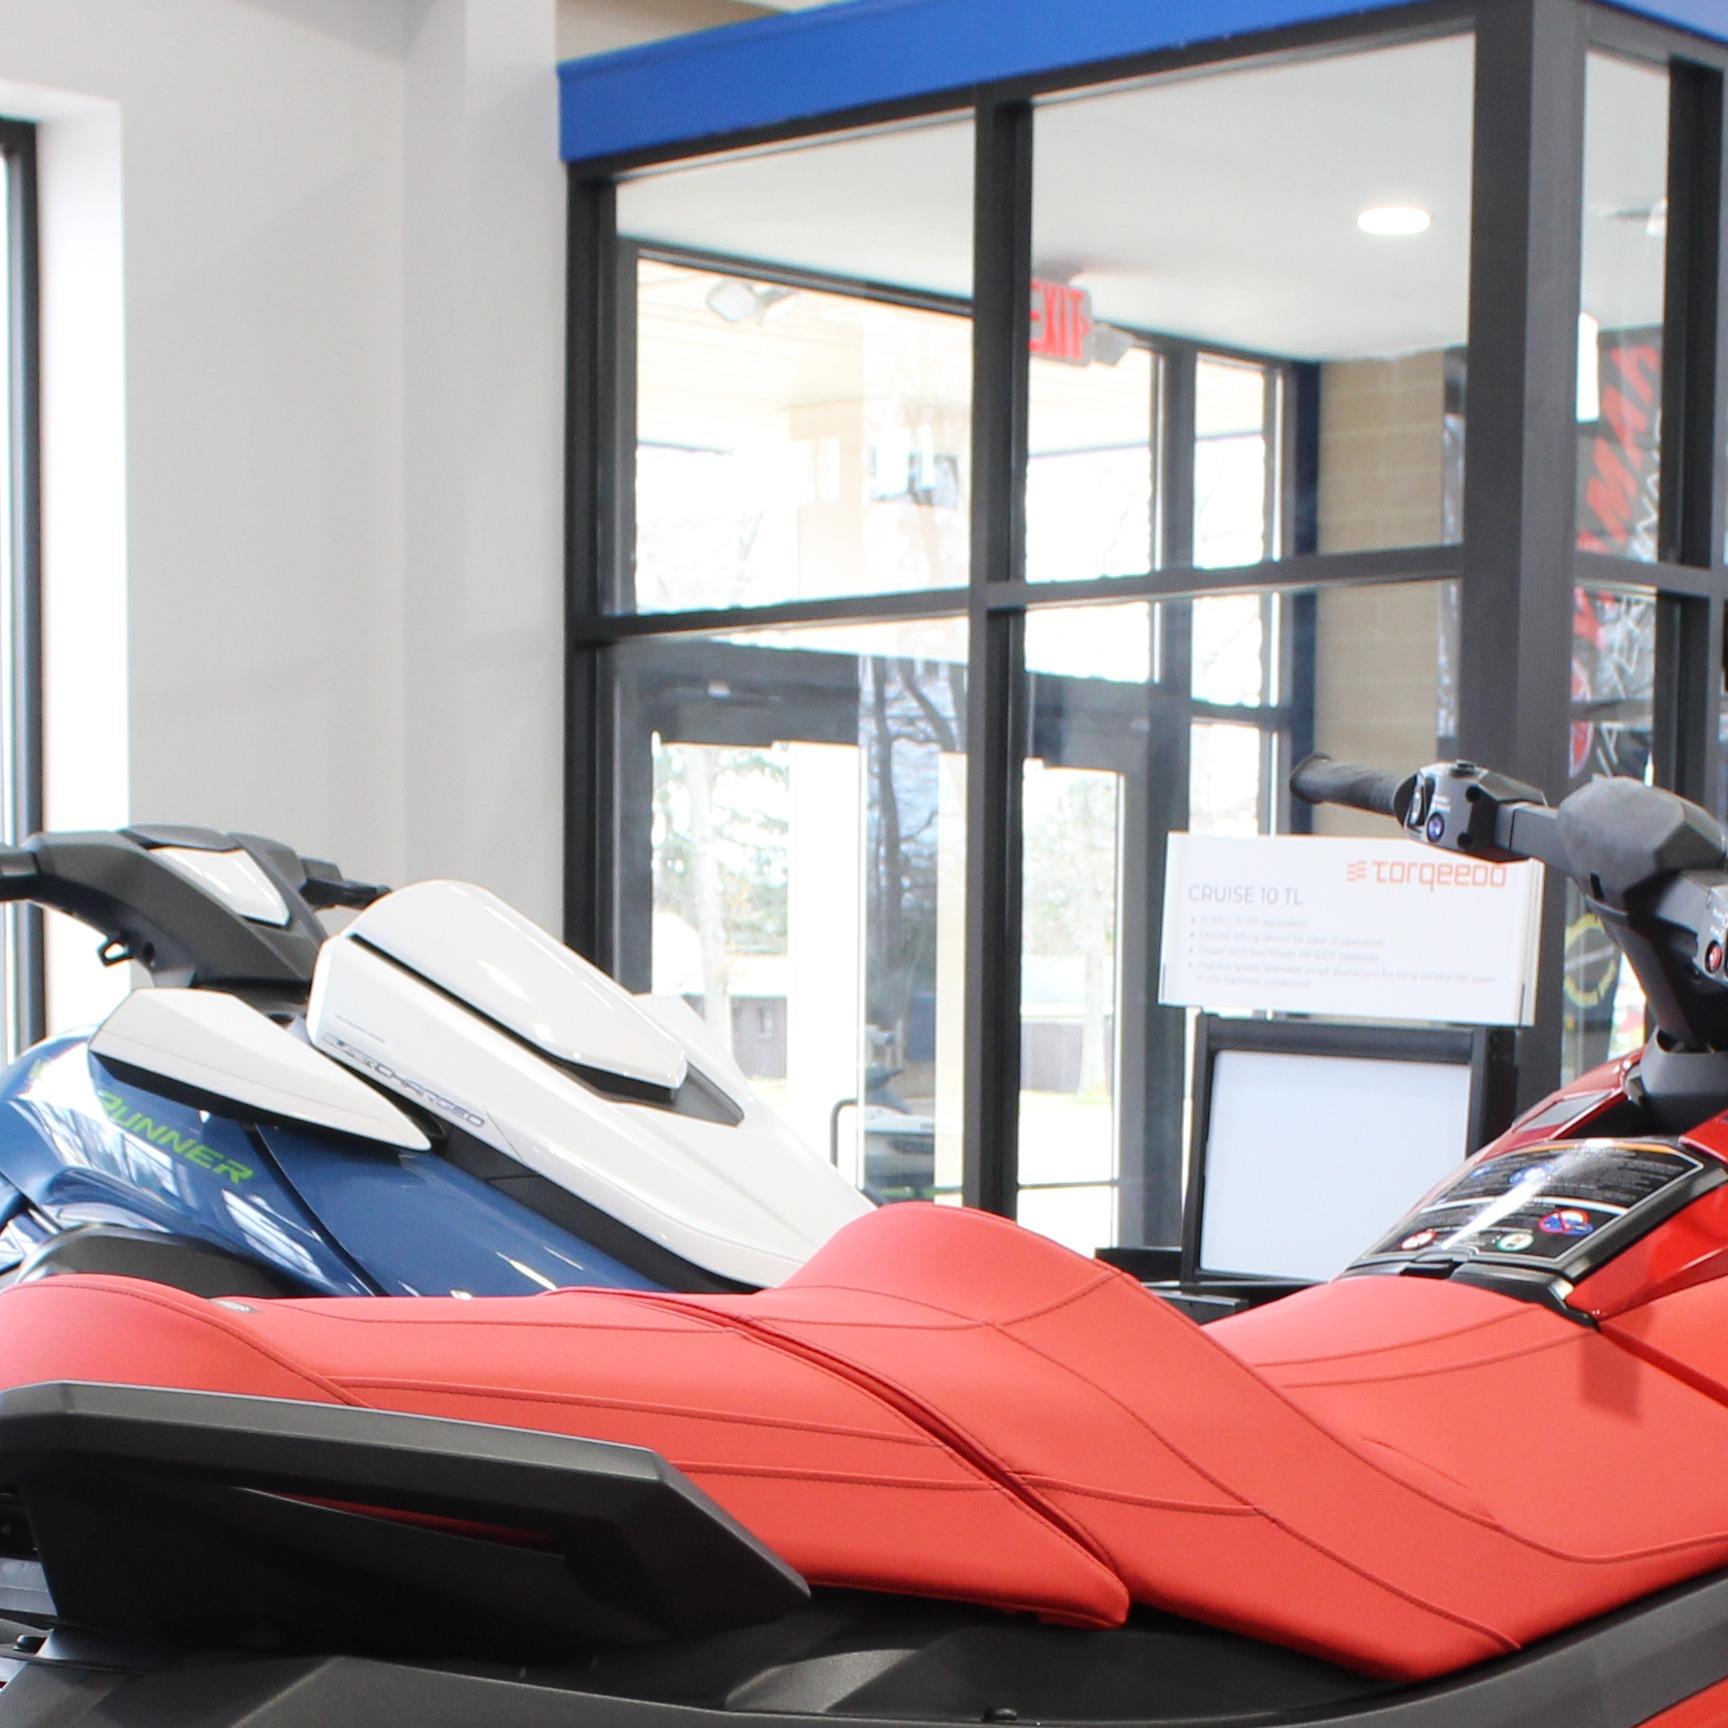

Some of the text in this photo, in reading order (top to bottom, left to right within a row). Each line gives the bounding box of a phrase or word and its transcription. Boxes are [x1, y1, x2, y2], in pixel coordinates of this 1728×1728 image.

[1188, 884, 1303, 906] CRUISE 10 TL
